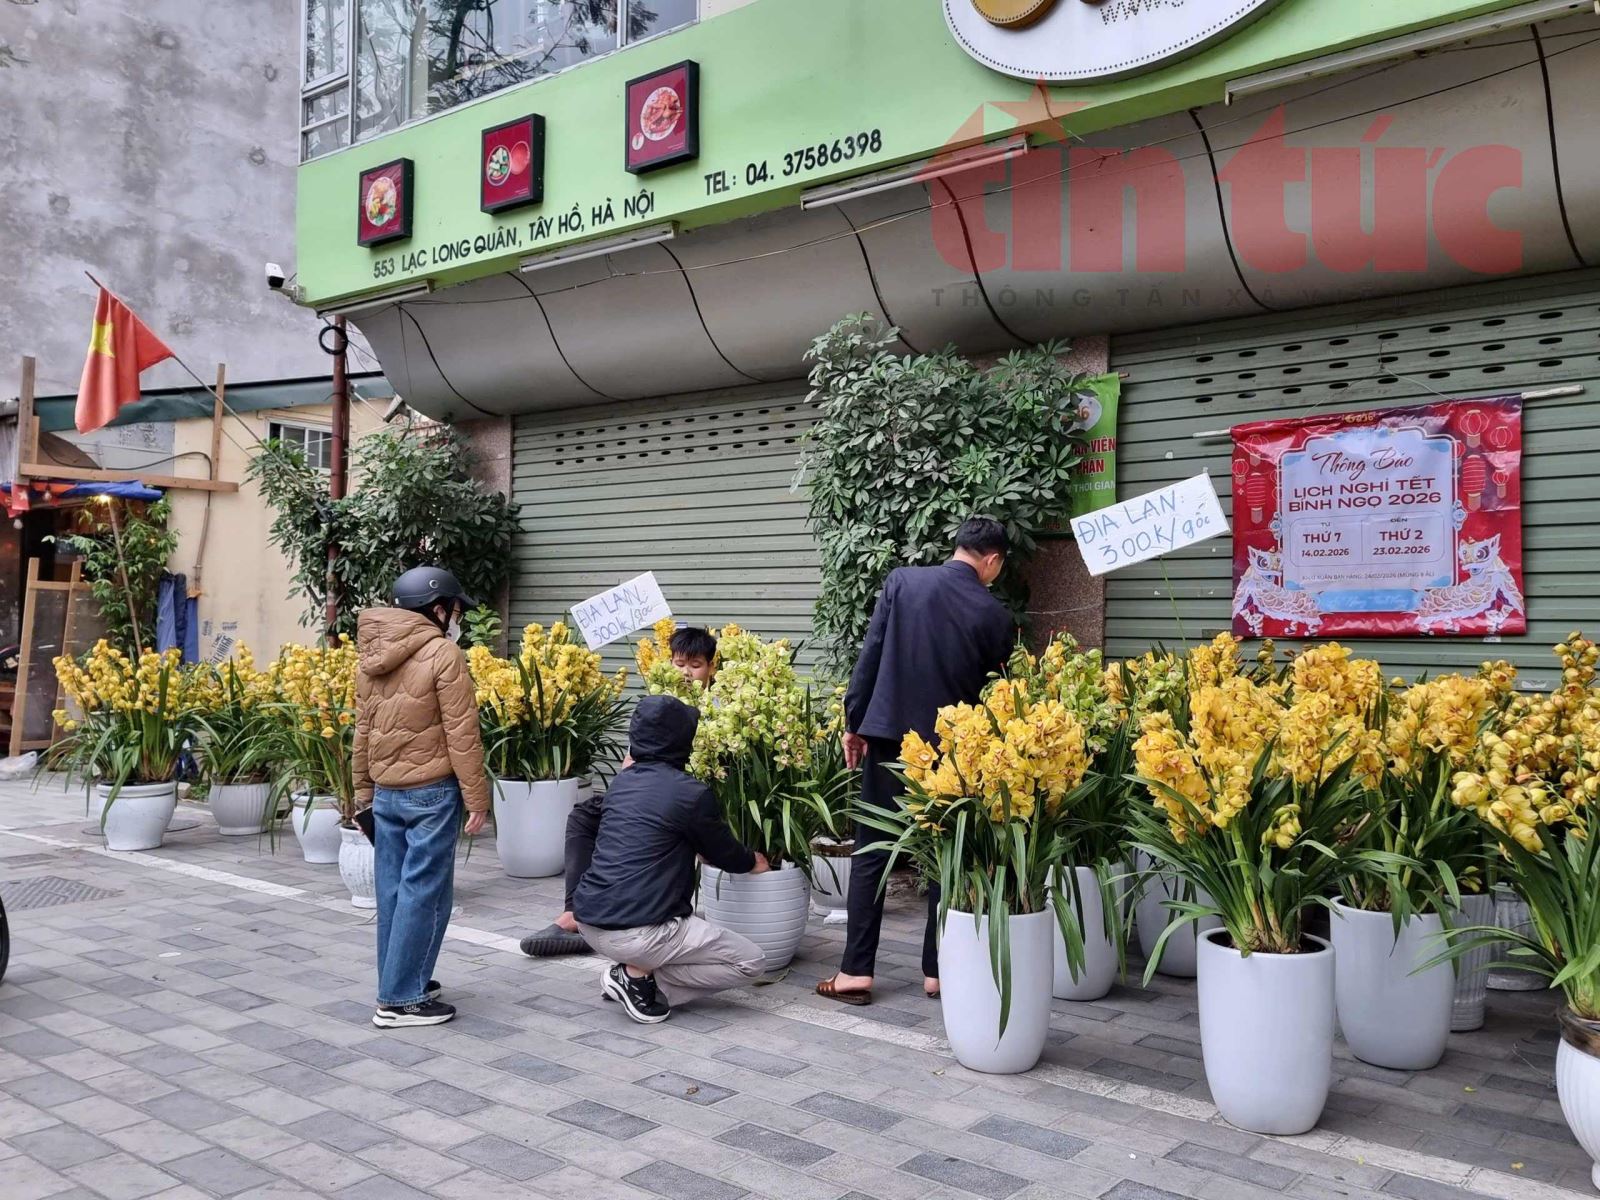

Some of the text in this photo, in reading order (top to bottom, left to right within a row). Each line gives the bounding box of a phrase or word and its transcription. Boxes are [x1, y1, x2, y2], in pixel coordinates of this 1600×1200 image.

[782, 128, 882, 177] 37586398
[373, 189, 654, 279] 553 LẠC LONG QUÂN, TÂY HỒ, HÀ NỘI
[1090, 434, 1116, 453] VIÊN
[1311, 446, 1414, 481] Thông Báo
[1294, 484, 1333, 499] LỊCH
[1338, 495, 1382, 509] NGỌ
[1388, 492, 1442, 506] 2026
[1302, 531, 1342, 543] THỨ 7
[1379, 528, 1424, 542] THỨ 2
[1301, 548, 1350, 558] 14.02.2026
[1372, 545, 1431, 556] 23.02.2026
